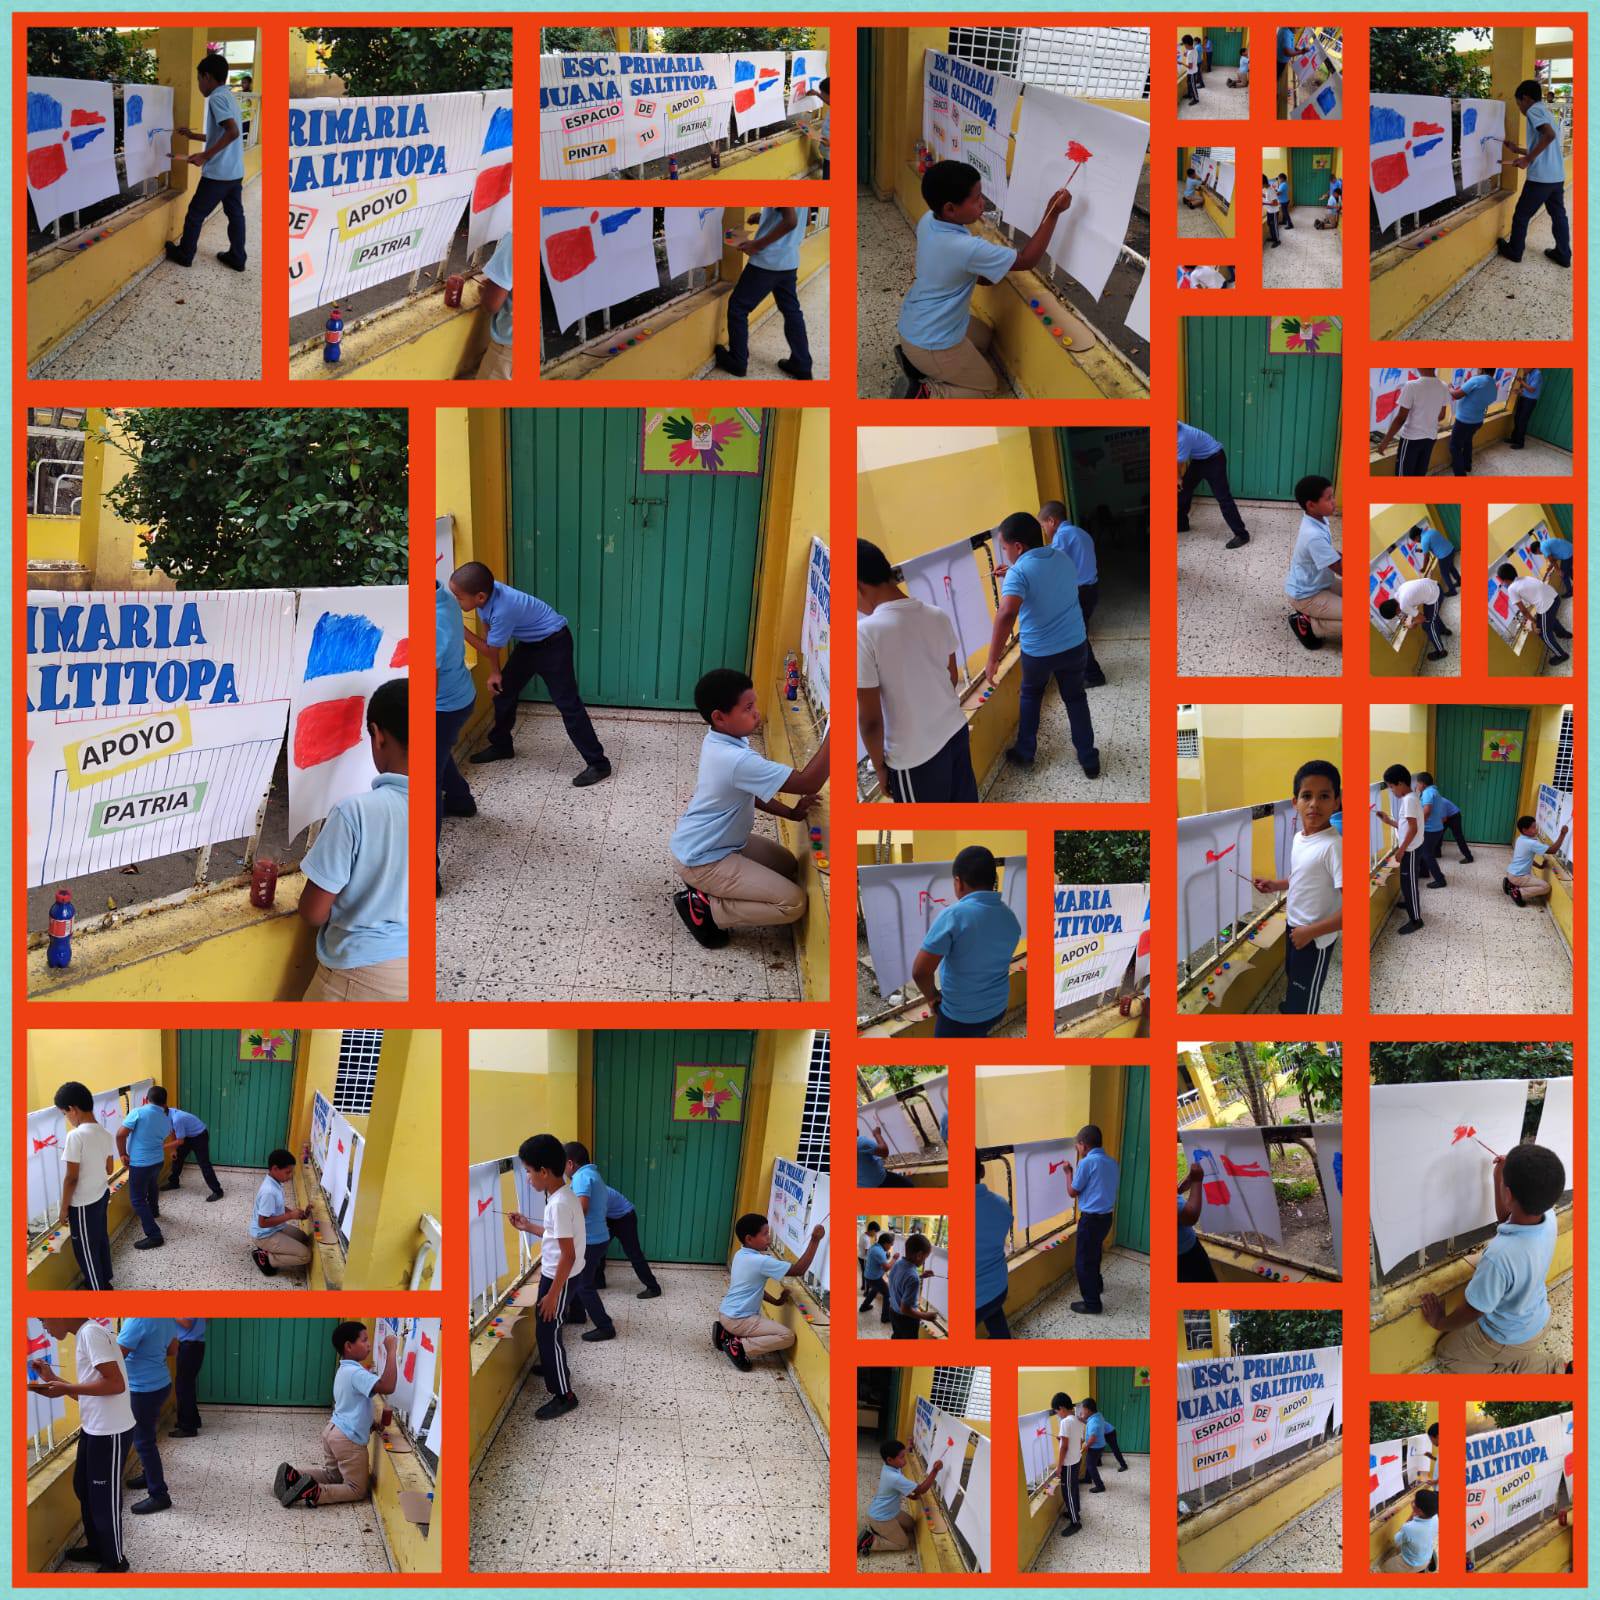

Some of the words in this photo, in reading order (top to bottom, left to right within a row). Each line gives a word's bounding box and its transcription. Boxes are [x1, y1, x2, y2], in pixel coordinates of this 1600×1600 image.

[563, 58, 615, 77] ESC.
[619, 56, 704, 75] PRIMARIA
[950, 59, 995, 97] PRIMARIA
[630, 75, 718, 97] SALTITOPA
[566, 106, 619, 129] ESPACIO
[639, 104, 652, 113] DE
[673, 96, 699, 112] APOYO
[951, 83, 997, 130] SALTITOPA
[569, 144, 607, 160] PINTA
[641, 130, 654, 141] TU
[681, 121, 706, 133] PATRIA
[965, 124, 981, 136] APOYO
[289, 144, 448, 192] ALTITOPA
[349, 189, 406, 227] APOYO
[359, 236, 410, 262] PATRIA
[27, 660, 240, 711] LTITOPA
[83, 722, 174, 770] APOYO
[104, 792, 187, 824] PATRIA
[1054, 914, 1123, 938] TITOPA
[1062, 941, 1098, 964] APOYO
[1068, 971, 1099, 986] PATRIA
[1193, 1364, 1239, 1389] ESC.
[1244, 1353, 1316, 1380] PRIMARIA
[1251, 1373, 1324, 1402] SALTITOPA
[1196, 1414, 1240, 1439] ESPACIO
[1256, 1409, 1267, 1417] DE
[1283, 1396, 1309, 1416] APOYO
[1197, 1451, 1228, 1467] PINTA
[1255, 1432, 1267, 1445] TU
[1288, 1420, 1311, 1434] PATRIA
[1468, 1493, 1481, 1502] DE
[1503, 1472, 1529, 1495] APOYO
[1471, 1516, 1484, 1529] TU
[1511, 1494, 1536, 1511] PATRIA
